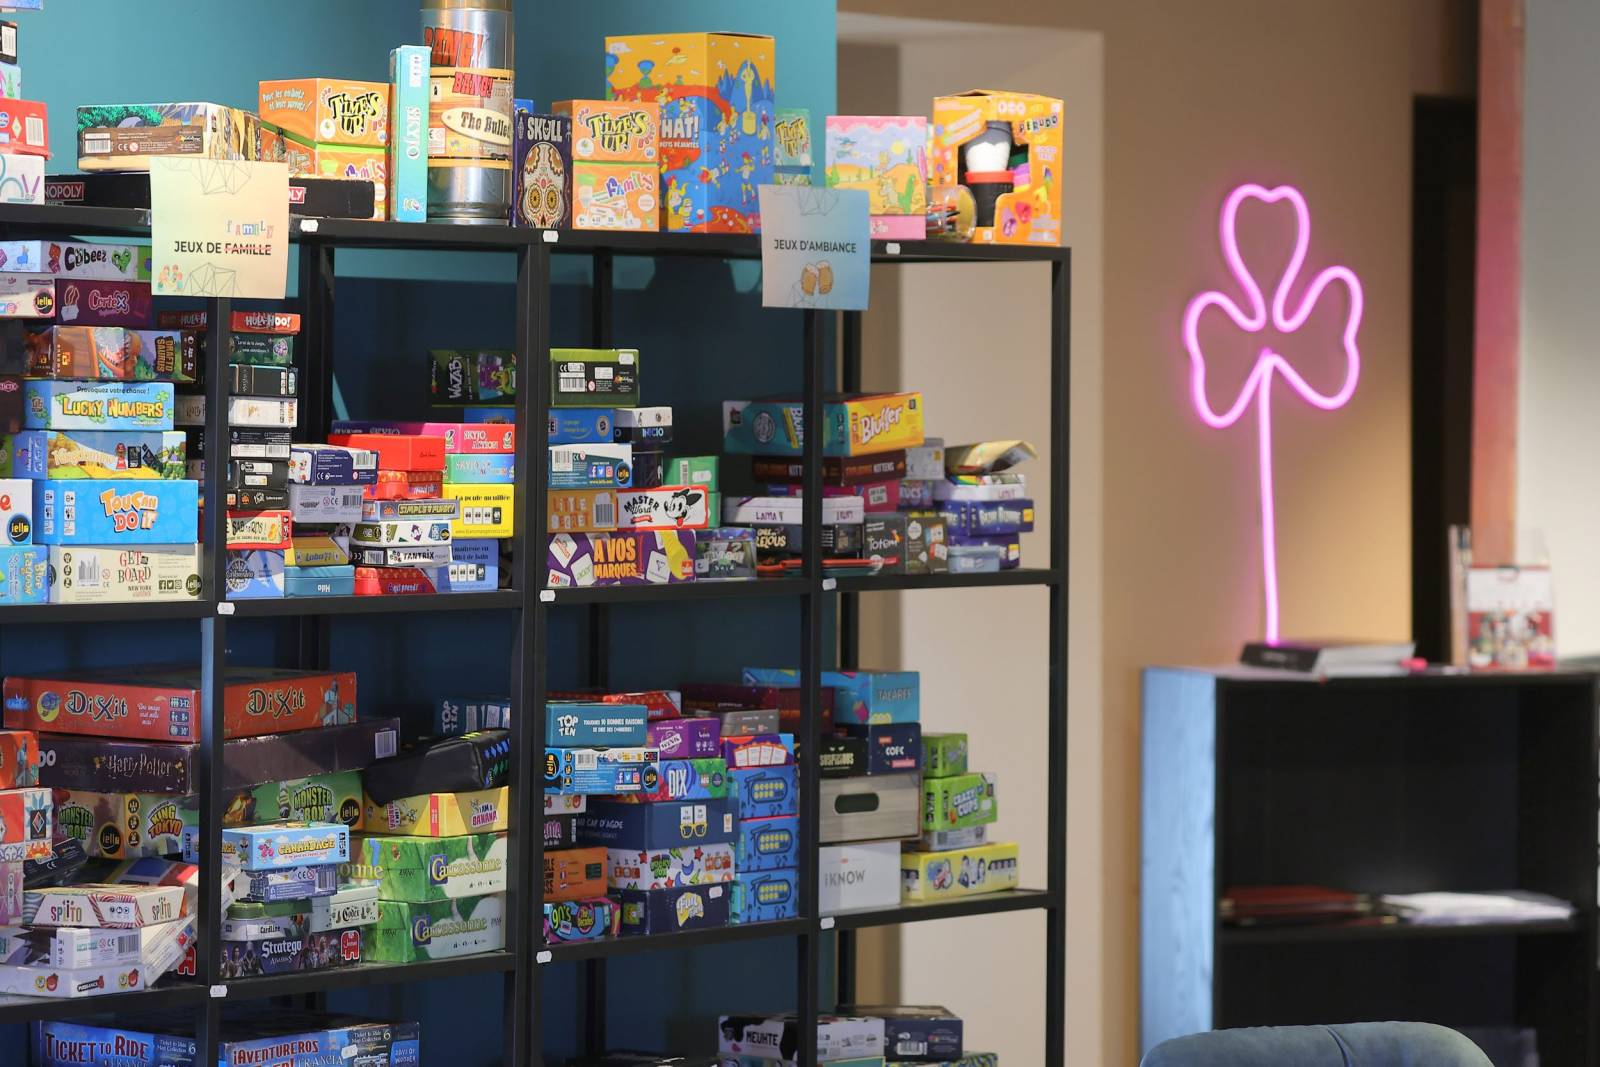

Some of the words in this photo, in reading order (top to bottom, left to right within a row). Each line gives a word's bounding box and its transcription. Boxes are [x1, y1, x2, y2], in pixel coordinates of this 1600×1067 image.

[452, 71, 494, 100] BANG!
[340, 114, 365, 133] UP!
[461, 111, 482, 131] The
[527, 116, 563, 143] SKULL
[600, 133, 631, 153] UP!
[45, 184, 82, 199] NOPOLY
[174, 241, 203, 254] JEUX
[206, 242, 222, 254] DE
[225, 243, 272, 256] FAMILLE
[774, 239, 797, 250] JEUX
[800, 240, 857, 254] D'AMBIANCE
[77, 386, 109, 396] Provoquez
[126, 386, 146, 394] chance
[62, 396, 104, 418] LUCKY
[106, 396, 164, 418] NUMBERS
[860, 404, 903, 446] Bluffer
[624, 496, 660, 513] MASTER
[113, 513, 139, 534] DO
[120, 550, 142, 567] GET
[593, 538, 606, 563] A
[607, 537, 636, 563] VOS
[118, 566, 152, 584] BOARD
[593, 563, 637, 579] MARQUES
[557, 714, 579, 728] TOP
[558, 727, 576, 738] TEN
[108, 752, 138, 778] Harry
[668, 767, 688, 798] DIX
[149, 802, 176, 826] KING
[148, 818, 184, 840] TOKYO
[261, 938, 302, 958] Stratego
[45, 1031, 97, 1065] TICKET
[100, 1042, 112, 1056] TO
[114, 1034, 150, 1060] RIDE
